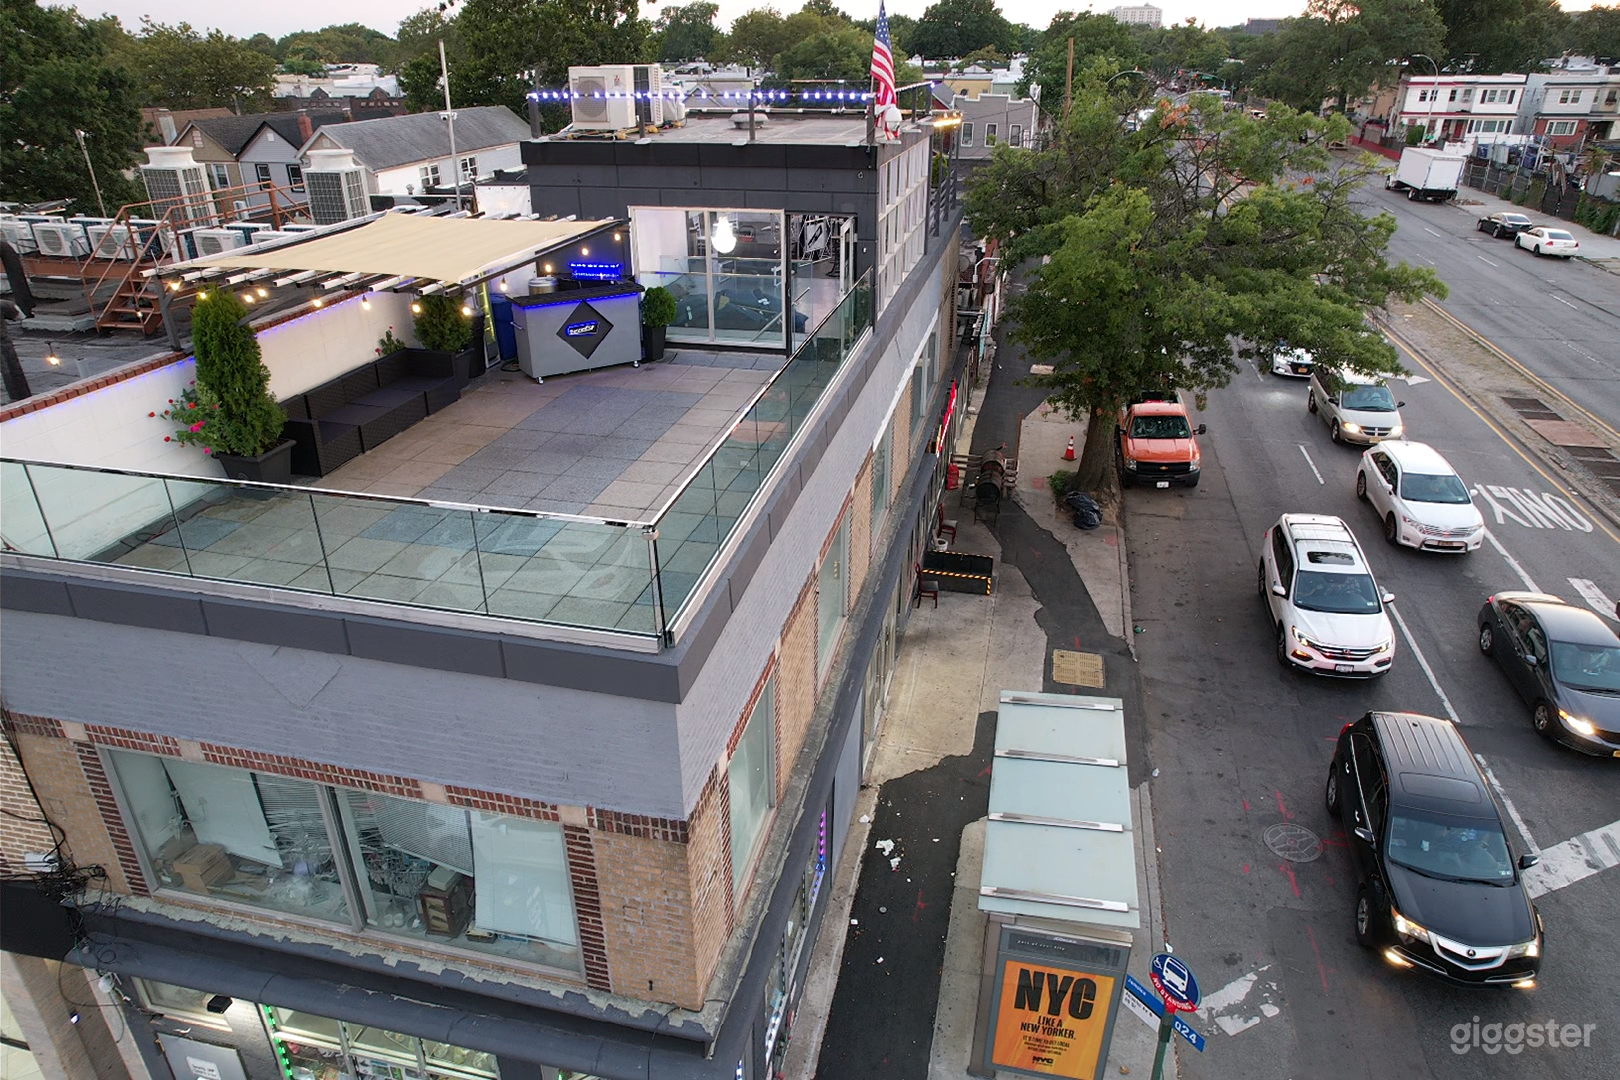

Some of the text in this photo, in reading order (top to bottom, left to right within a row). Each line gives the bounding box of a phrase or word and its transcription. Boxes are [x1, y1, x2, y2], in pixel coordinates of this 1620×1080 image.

[1474, 483, 1593, 533] ONLY
[1152, 977, 1161, 988] NO
[1014, 968, 1097, 1020] NYC
[1020, 1022, 1076, 1040] NEW YORKER.
[1037, 1015, 1063, 1028] LIKE A
[1175, 1021, 1197, 1044] Q24
